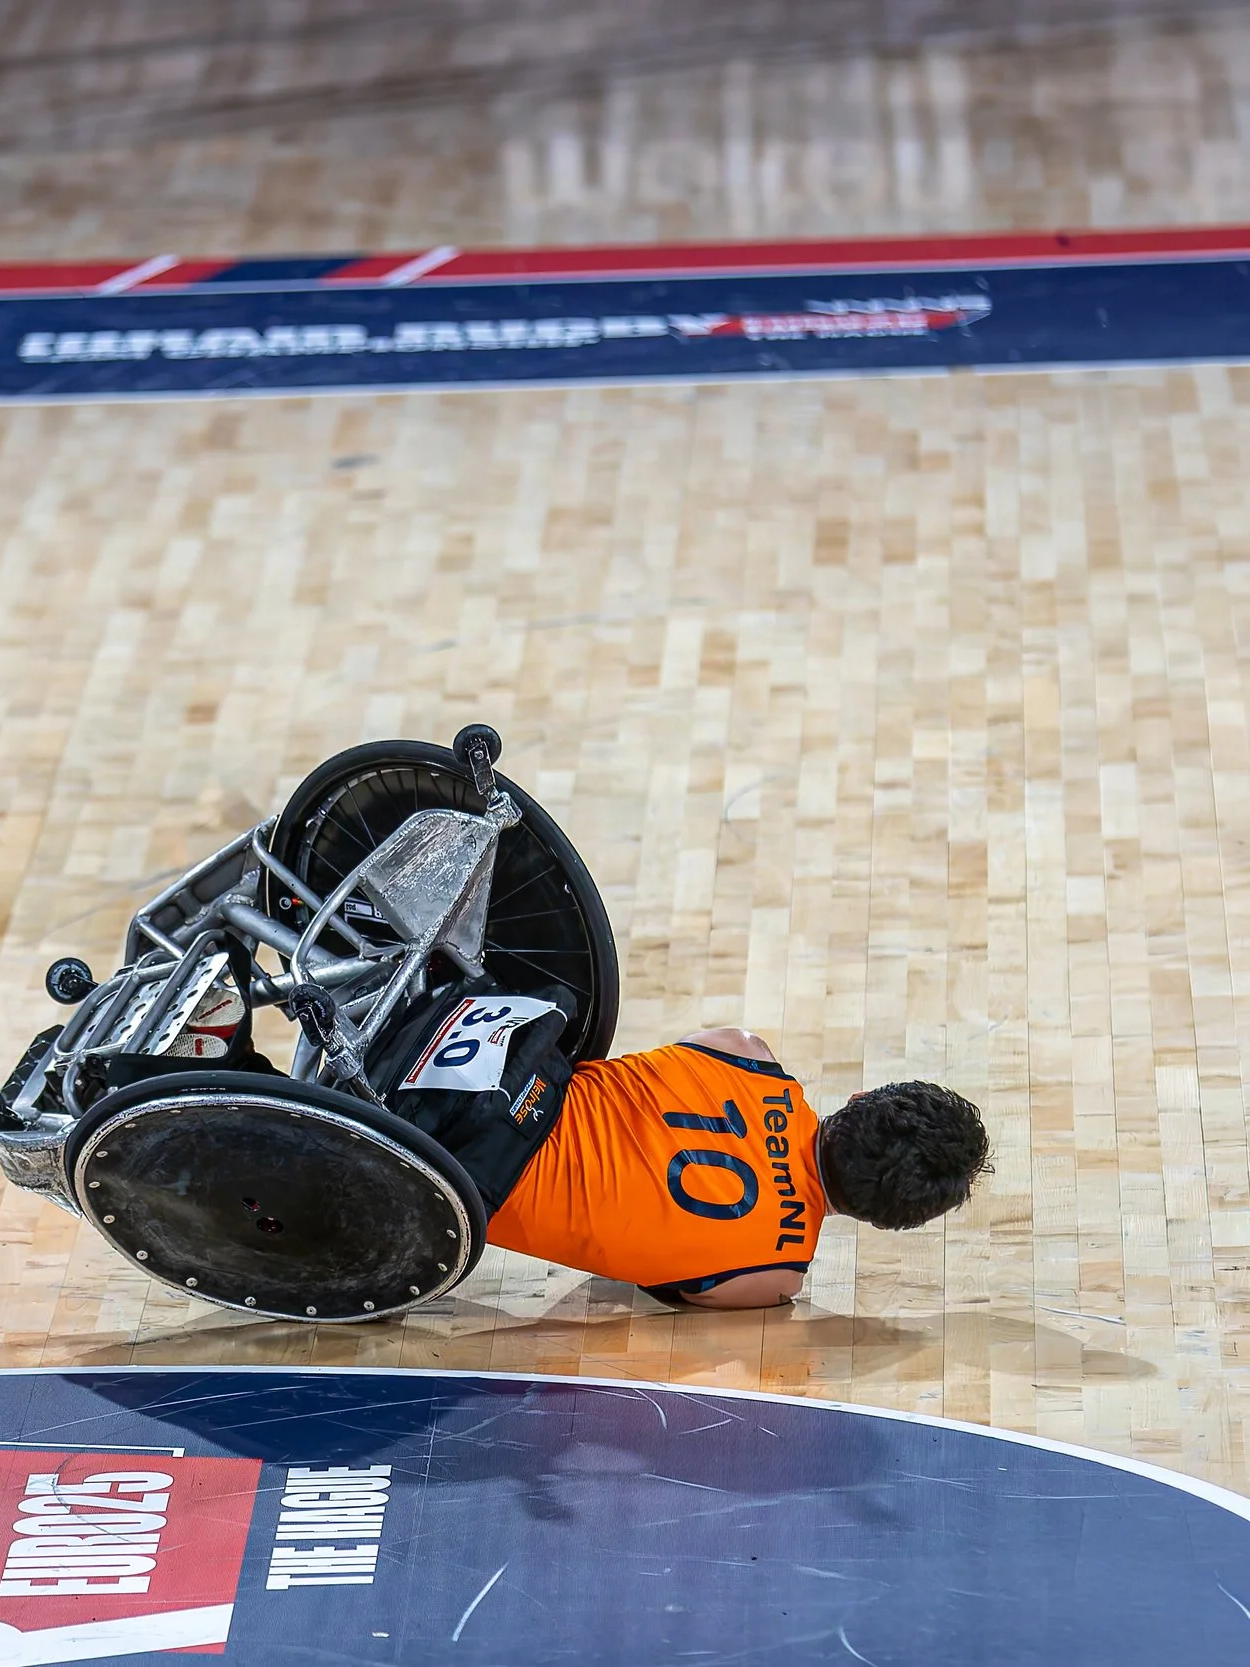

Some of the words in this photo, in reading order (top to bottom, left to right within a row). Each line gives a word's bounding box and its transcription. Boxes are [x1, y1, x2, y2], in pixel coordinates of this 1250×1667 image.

[433, 1006, 512, 1067] 3.0
[662, 1099, 759, 1220] 10
[762, 1088, 806, 1251] TeamNL
[275, 1464, 392, 1541] HAGUE
[265, 1544, 379, 1591] THE
